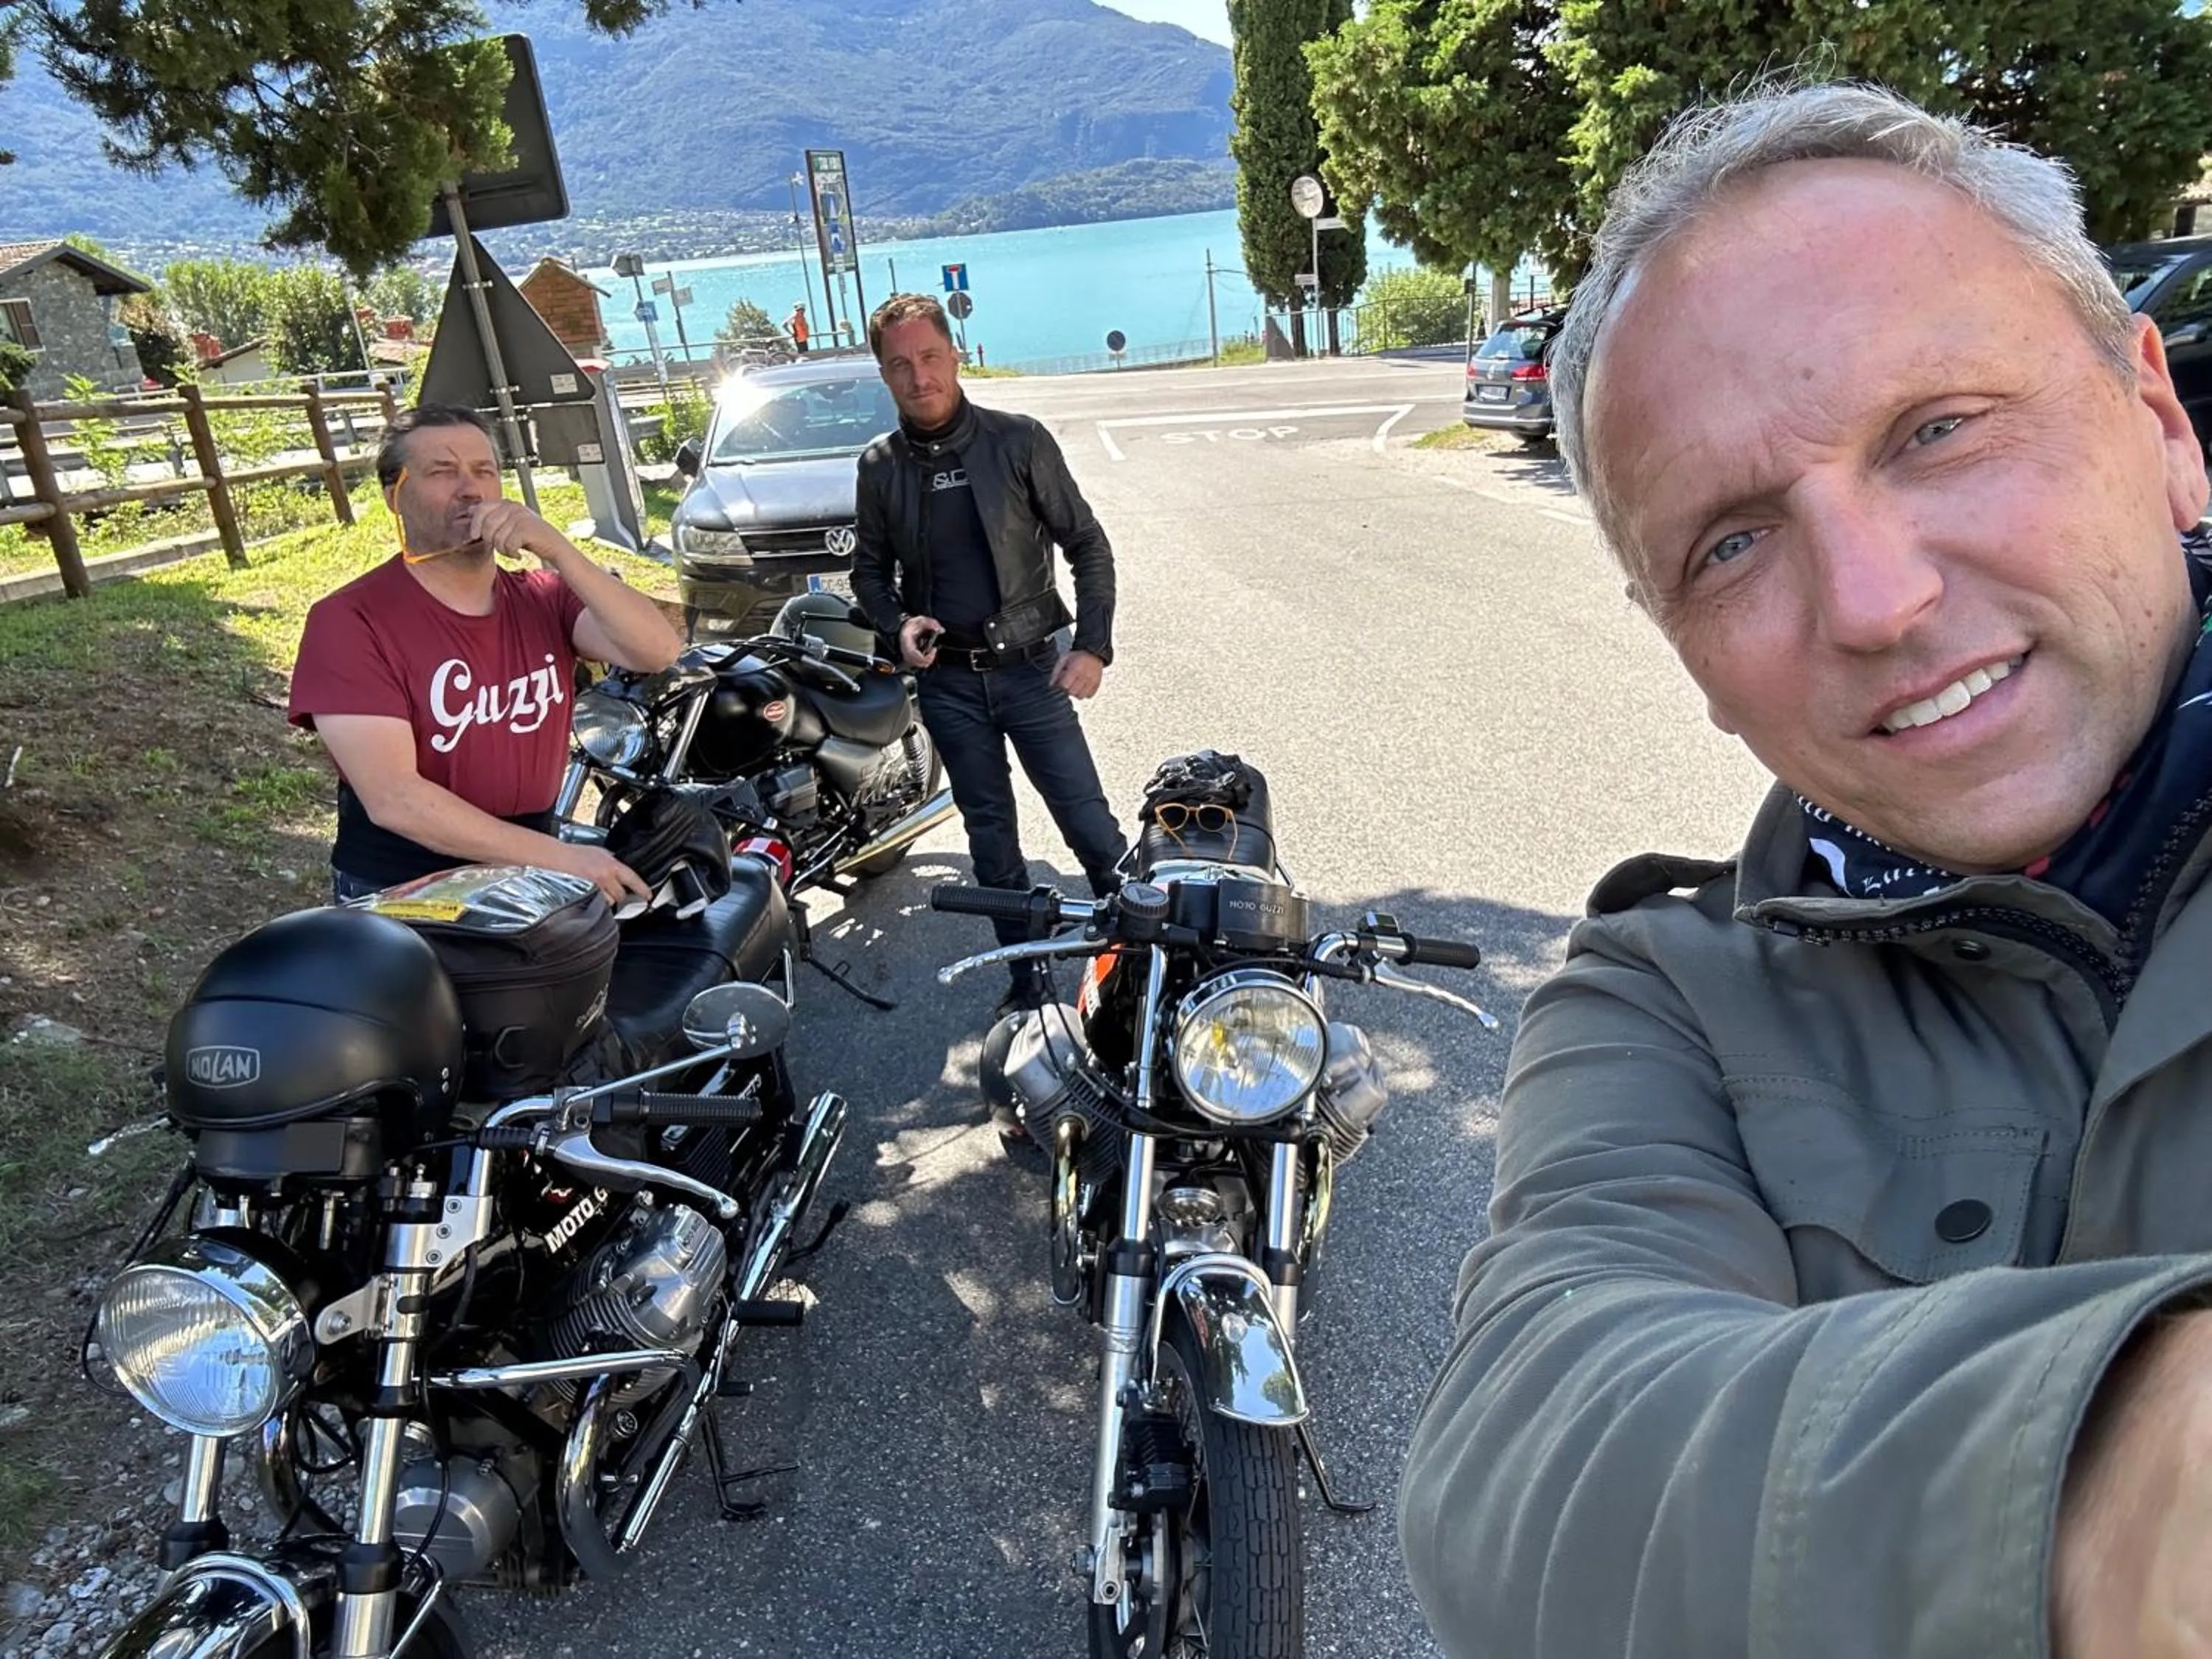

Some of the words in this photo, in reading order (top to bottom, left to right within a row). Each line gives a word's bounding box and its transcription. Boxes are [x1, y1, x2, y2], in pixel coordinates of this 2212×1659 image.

[1160, 425, 1298, 444] STOP
[430, 654, 563, 753] Guzzi
[191, 1051, 251, 1082] NOLAN
[543, 1197, 595, 1253] MOTO
